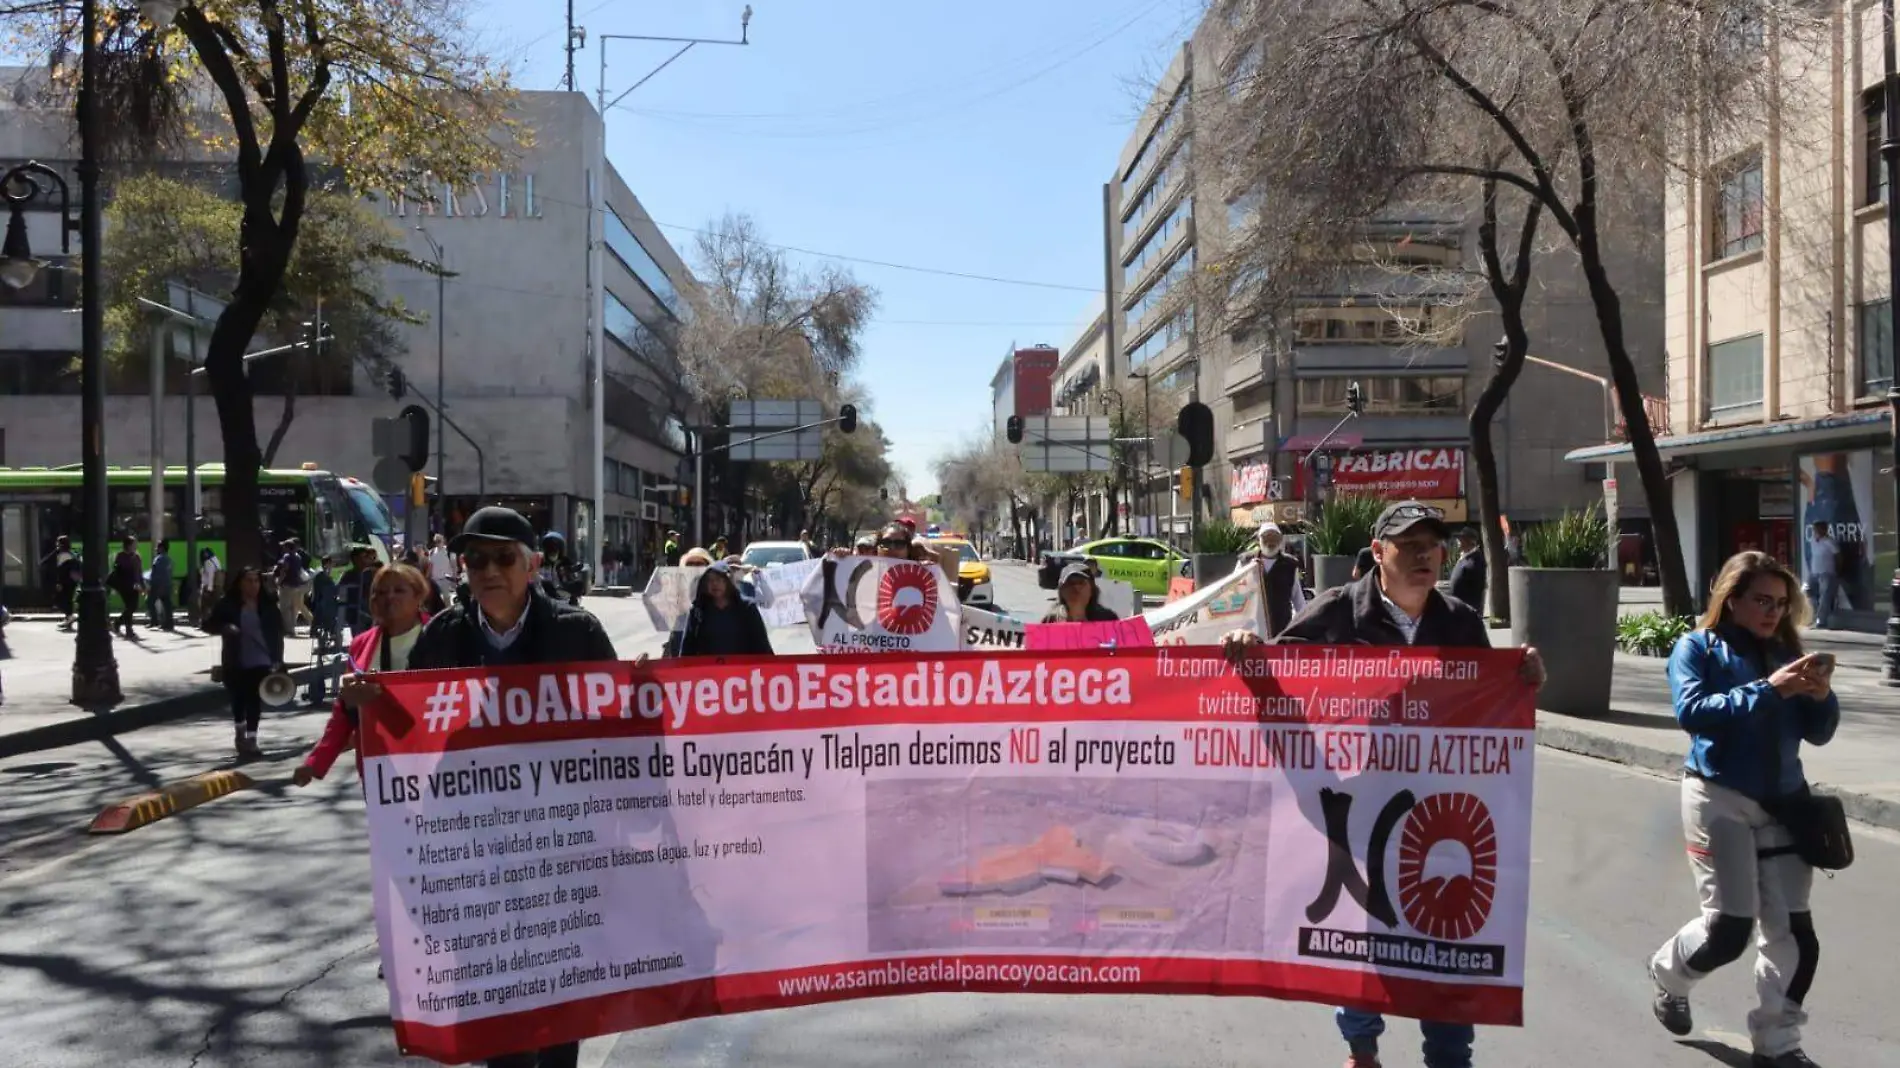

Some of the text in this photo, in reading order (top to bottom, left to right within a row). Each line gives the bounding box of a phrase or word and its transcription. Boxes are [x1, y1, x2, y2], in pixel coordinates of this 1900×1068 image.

[833, 632, 911, 649] AL PROYECTO
[423, 659, 1131, 732] #NoAlProyectoEstadioAzteca
[1198, 687, 1430, 725] twitter.com/vecinos_las
[377, 727, 1524, 804] Los vecinos y vecinas de Coyoacán y Tlalpan decimos NO al proyecto "CONJUNTO ESTADIO AZTECA"
[415, 810, 471, 836] Pretende
[474, 806, 521, 828] realizar
[524, 808, 545, 823] una
[549, 801, 580, 822] mega
[583, 795, 614, 818] plaza
[677, 788, 706, 807] hotel
[709, 794, 716, 805] y
[718, 788, 806, 809] departamentos.
[418, 828, 597, 866] Afectará la vialidad en la zona.
[420, 869, 487, 896] Aumentará
[490, 865, 500, 885] el
[503, 865, 537, 884] costo
[538, 858, 553, 878] de
[556, 852, 609, 876] servicios
[612, 849, 654, 869] básicos
[694, 839, 709, 857] luz
[712, 845, 719, 859] y
[422, 884, 601, 926] Habrá mayor escasez de agua.
[425, 911, 604, 956] Se saturará el drenaje público.
[1309, 928, 1494, 970] AlConjuntoAzteca
[427, 944, 584, 985] Aumentará la delincuencia.
[484, 977, 547, 1005] organízate
[550, 979, 557, 995] y
[559, 963, 606, 990] defiende
[609, 961, 621, 978] tu
[623, 952, 686, 980] patrimonio.
[778, 957, 1141, 997] www.asambleatlalpancoyoacan.com
